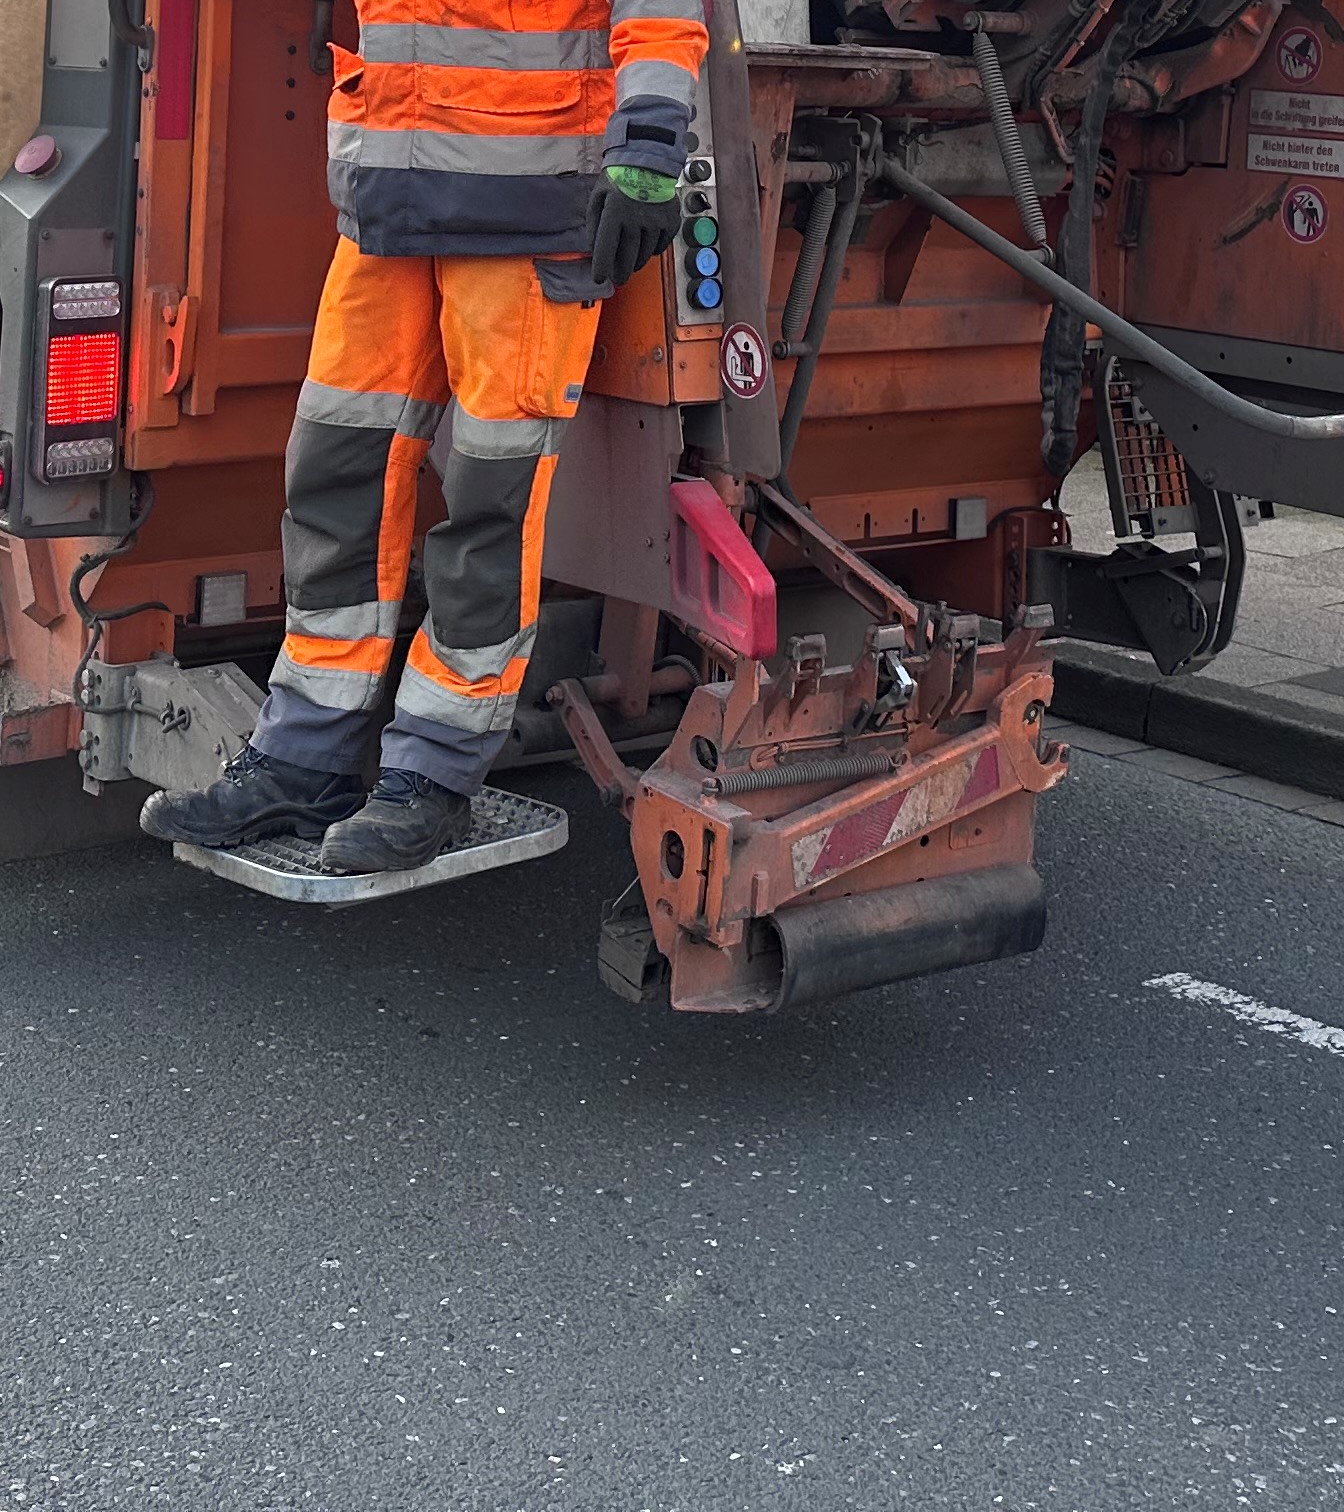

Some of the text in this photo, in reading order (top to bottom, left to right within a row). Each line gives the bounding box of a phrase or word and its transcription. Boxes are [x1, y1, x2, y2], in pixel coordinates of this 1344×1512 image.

[1289, 97, 1310, 110] Nicht
[1262, 139, 1333, 156] Nicht hinter den
[1254, 154, 1339, 173] Schwenkarm treten
